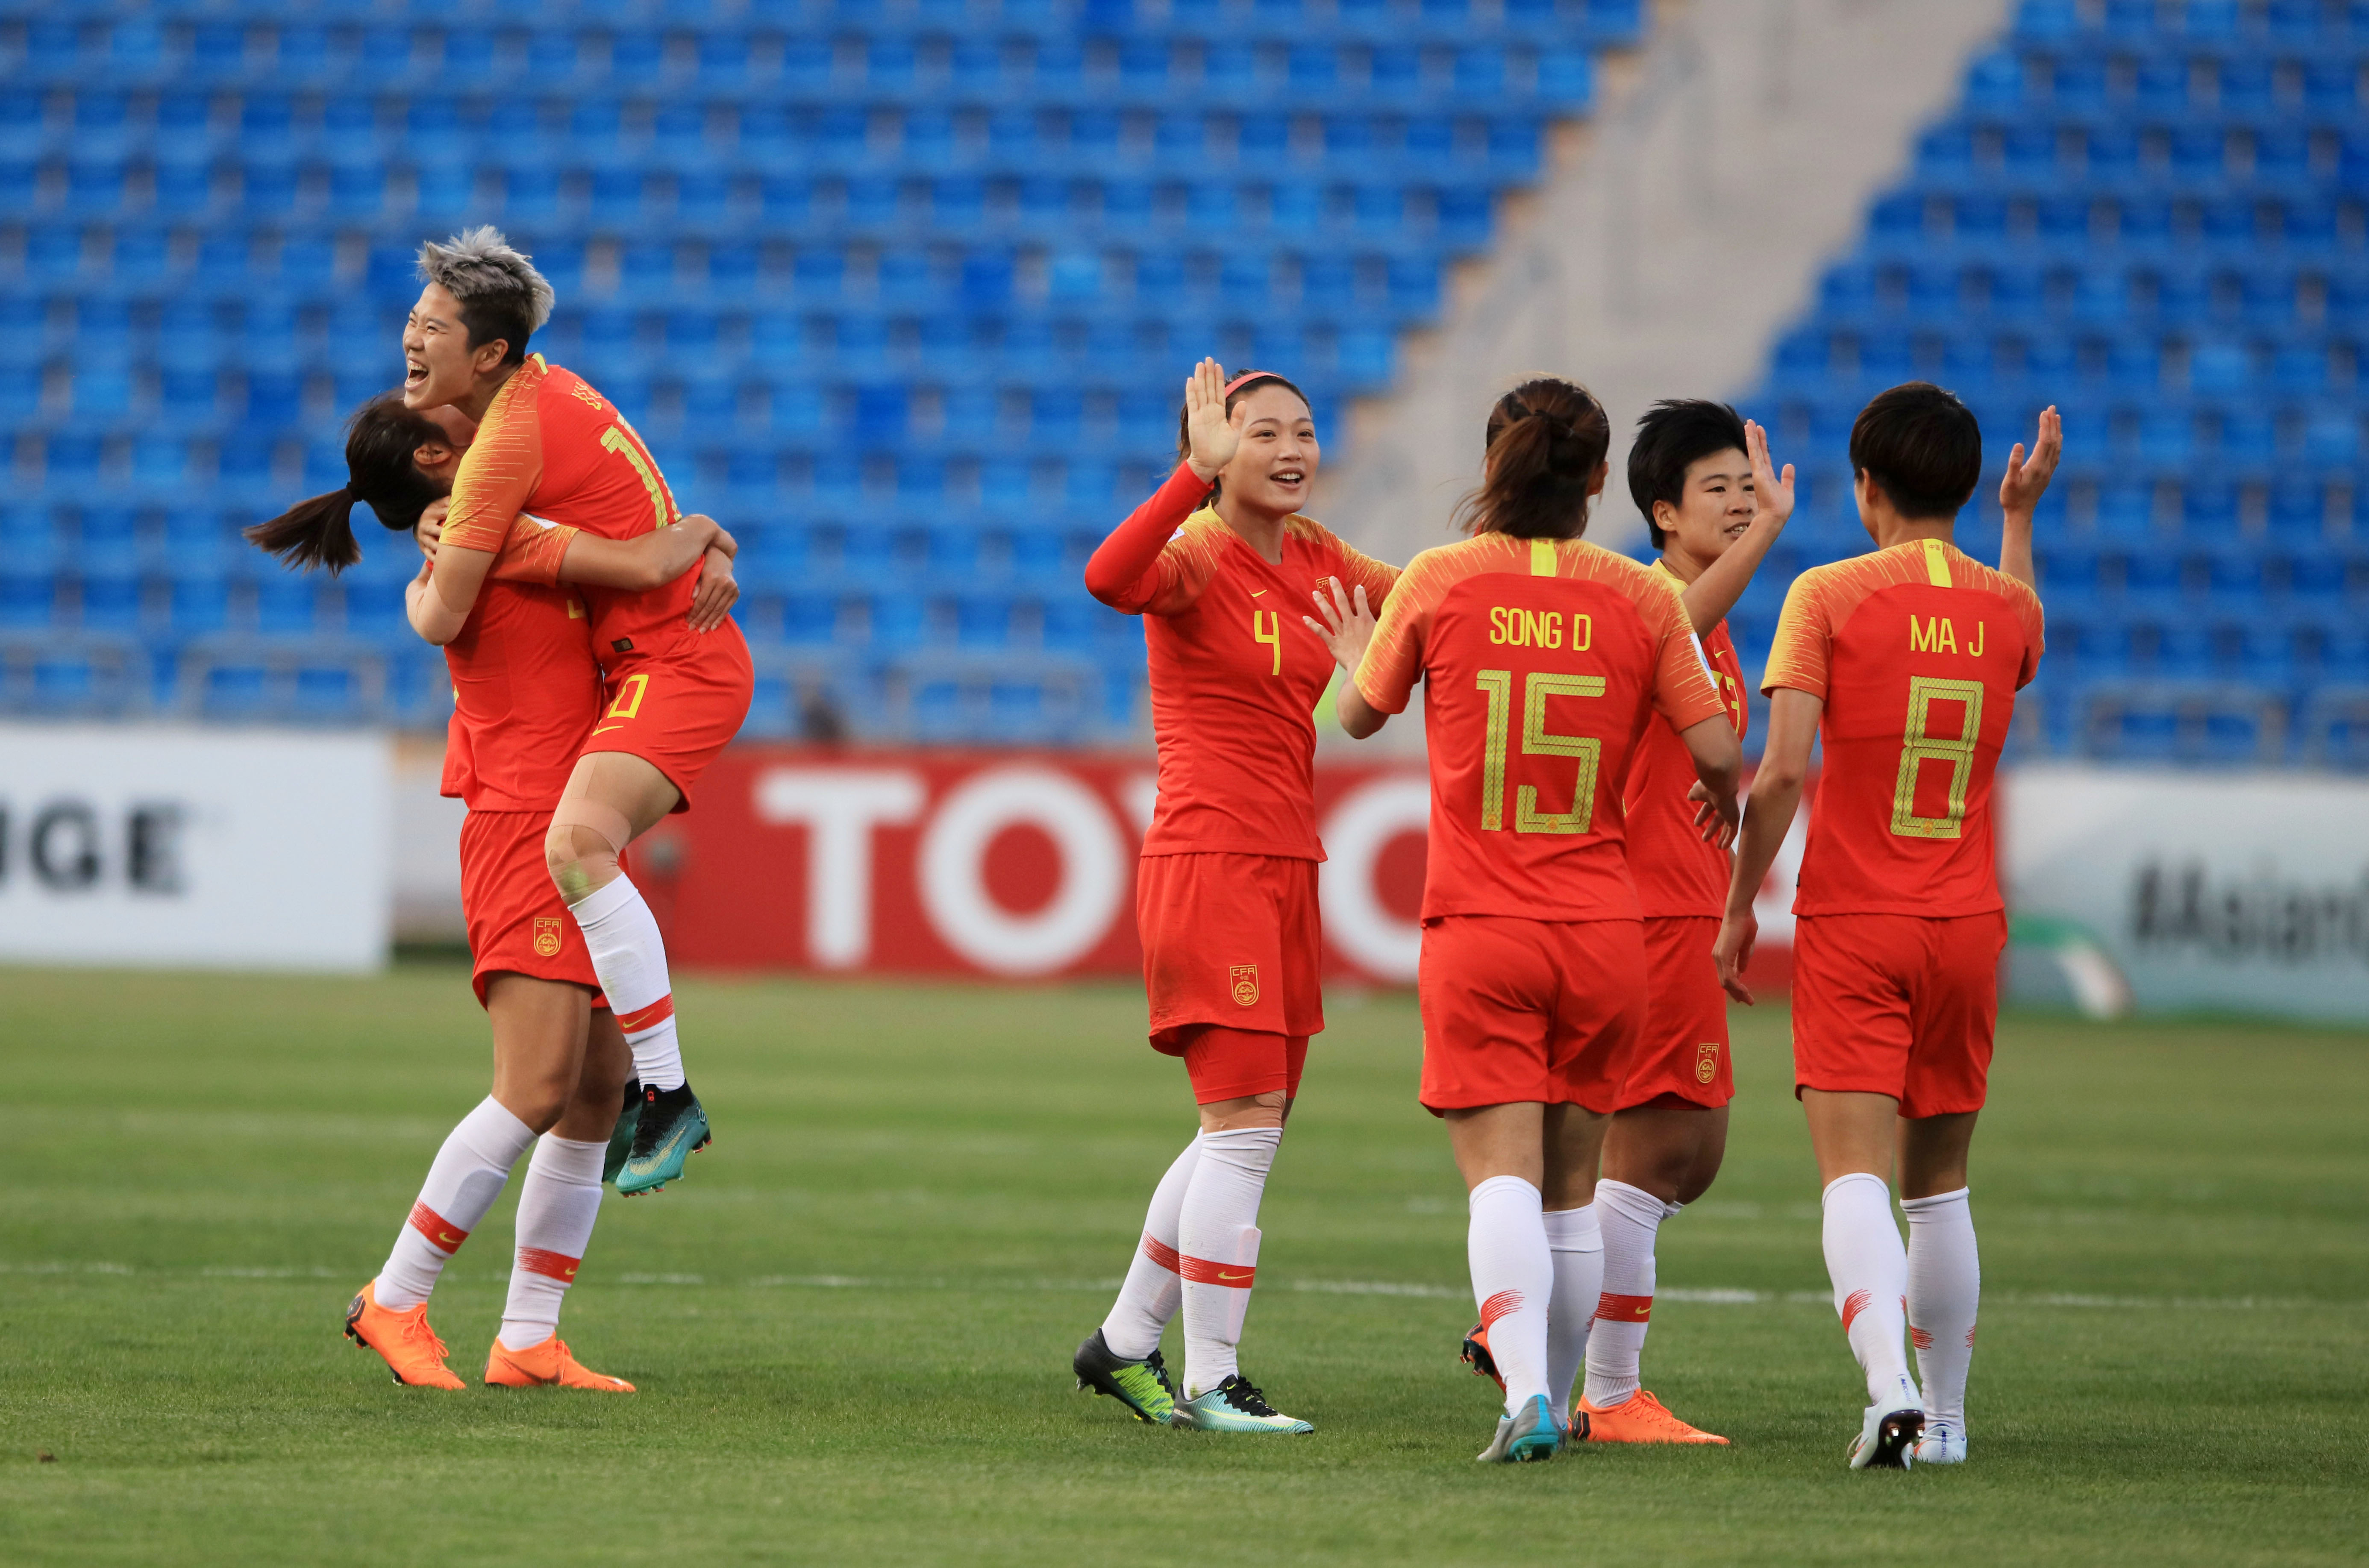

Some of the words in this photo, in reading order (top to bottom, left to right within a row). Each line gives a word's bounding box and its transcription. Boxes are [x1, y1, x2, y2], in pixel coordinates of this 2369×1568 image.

[600, 412, 682, 529] 1
[1254, 610, 1281, 676] 4
[1490, 606, 1563, 649] SONG
[1573, 614, 1592, 652] D
[1910, 614, 1958, 654] MA
[1969, 621, 1984, 657] J
[1476, 669, 1606, 834] 15
[1890, 675, 1984, 838] 8
[0, 797, 187, 896] GE
[537, 920, 559, 928] CFA
[1232, 967, 1255, 976] CFA
